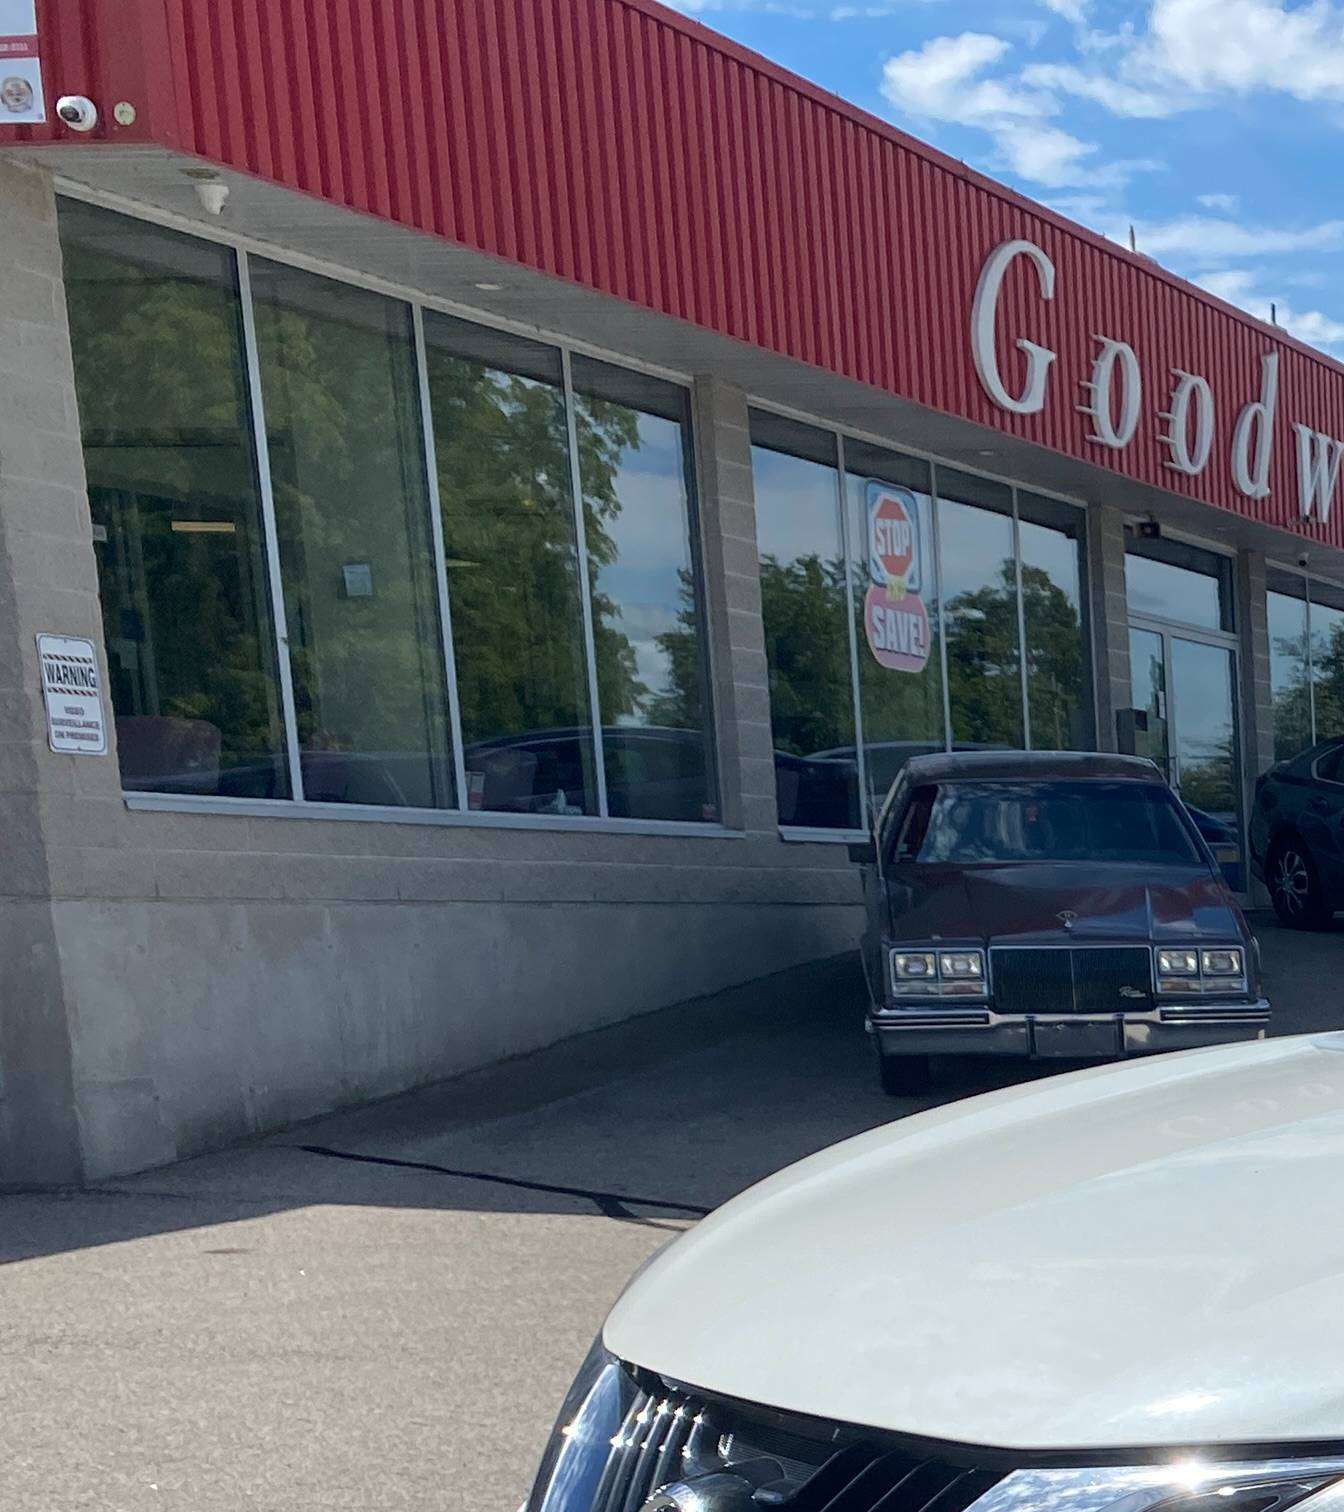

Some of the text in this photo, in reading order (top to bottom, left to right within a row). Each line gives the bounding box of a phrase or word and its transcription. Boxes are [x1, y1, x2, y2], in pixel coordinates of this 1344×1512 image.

[876, 519, 910, 557] STOP
[872, 604, 926, 658] SAVE!
[44, 663, 97, 689] WARNING
